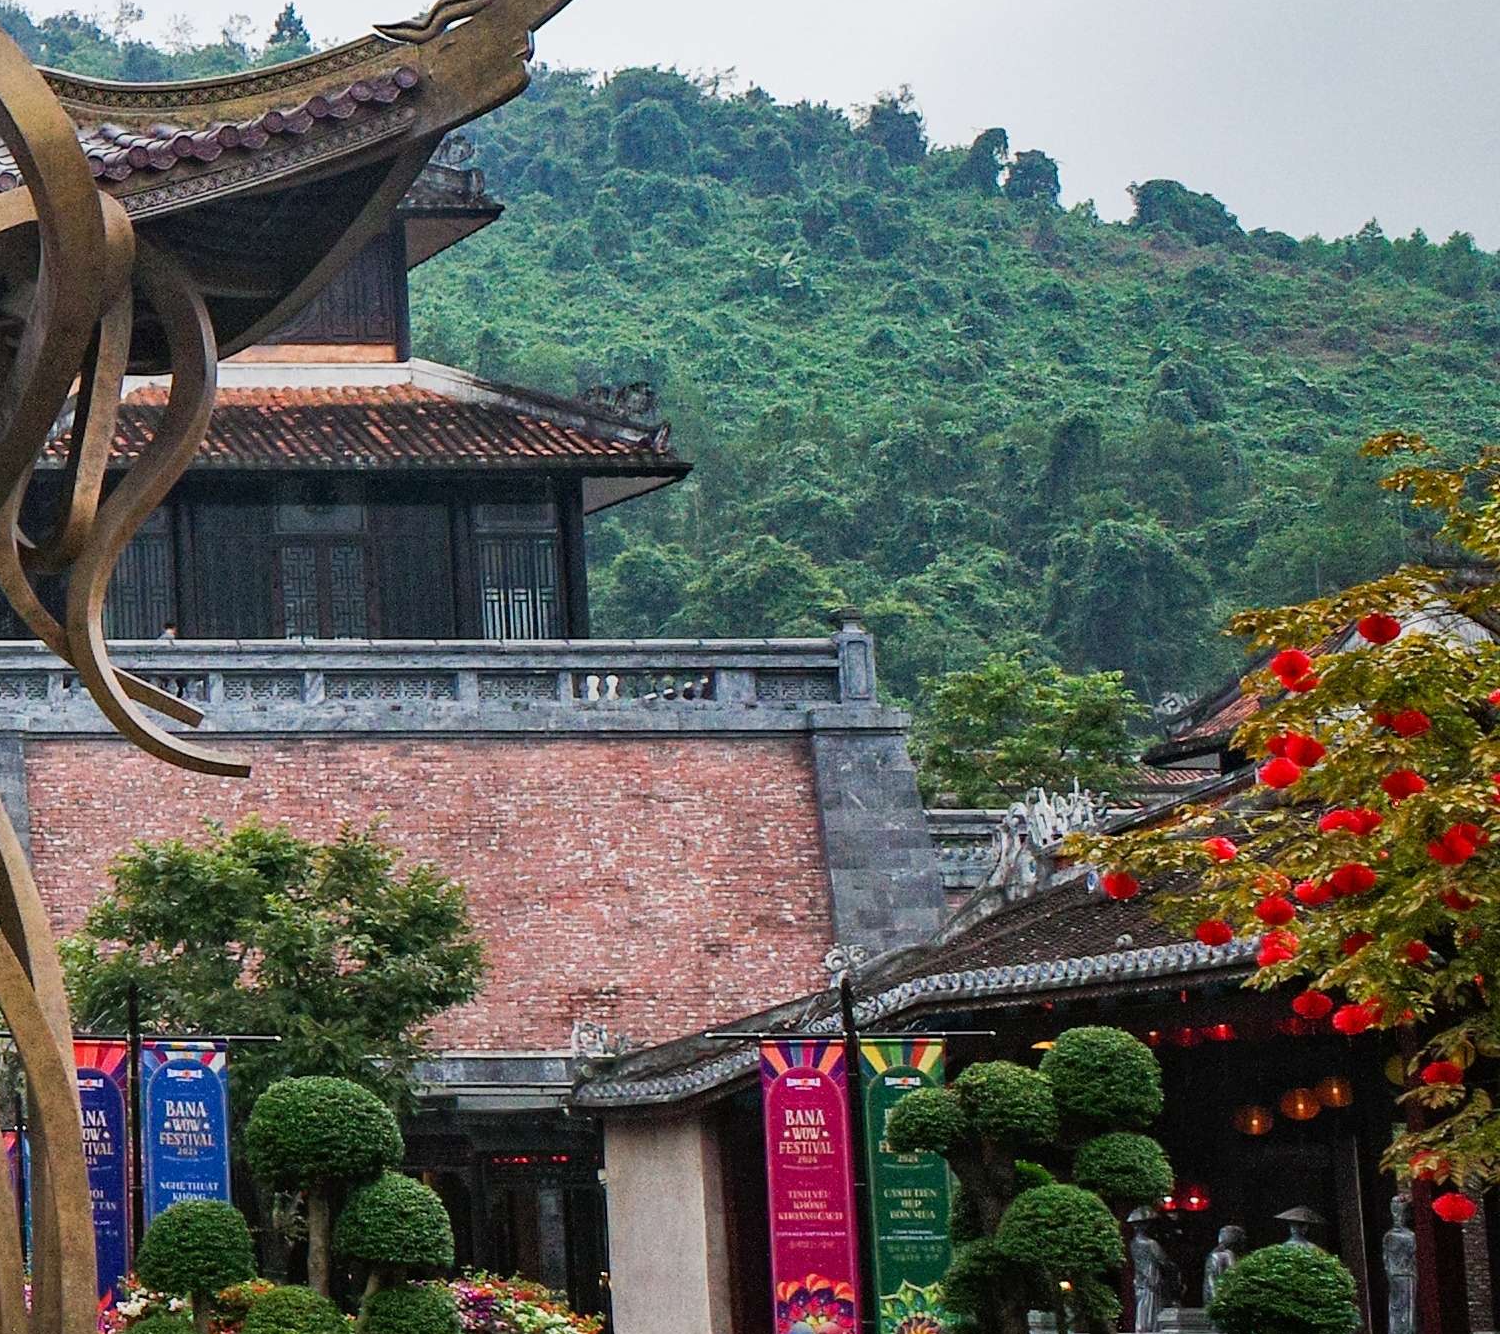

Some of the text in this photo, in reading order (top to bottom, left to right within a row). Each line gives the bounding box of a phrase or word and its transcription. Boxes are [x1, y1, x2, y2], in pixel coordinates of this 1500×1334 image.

[166, 1100, 207, 1117] BANA
[80, 1110, 108, 1127] ANA
[171, 1118, 201, 1131] WOW
[785, 1110, 825, 1126] BANA
[82, 1129, 100, 1142] OW
[159, 1132, 215, 1147] FESTIVAL
[792, 1127, 821, 1140] WOW
[82, 1143, 114, 1156] TIVAL
[779, 1142, 835, 1154] FESTIVAL
